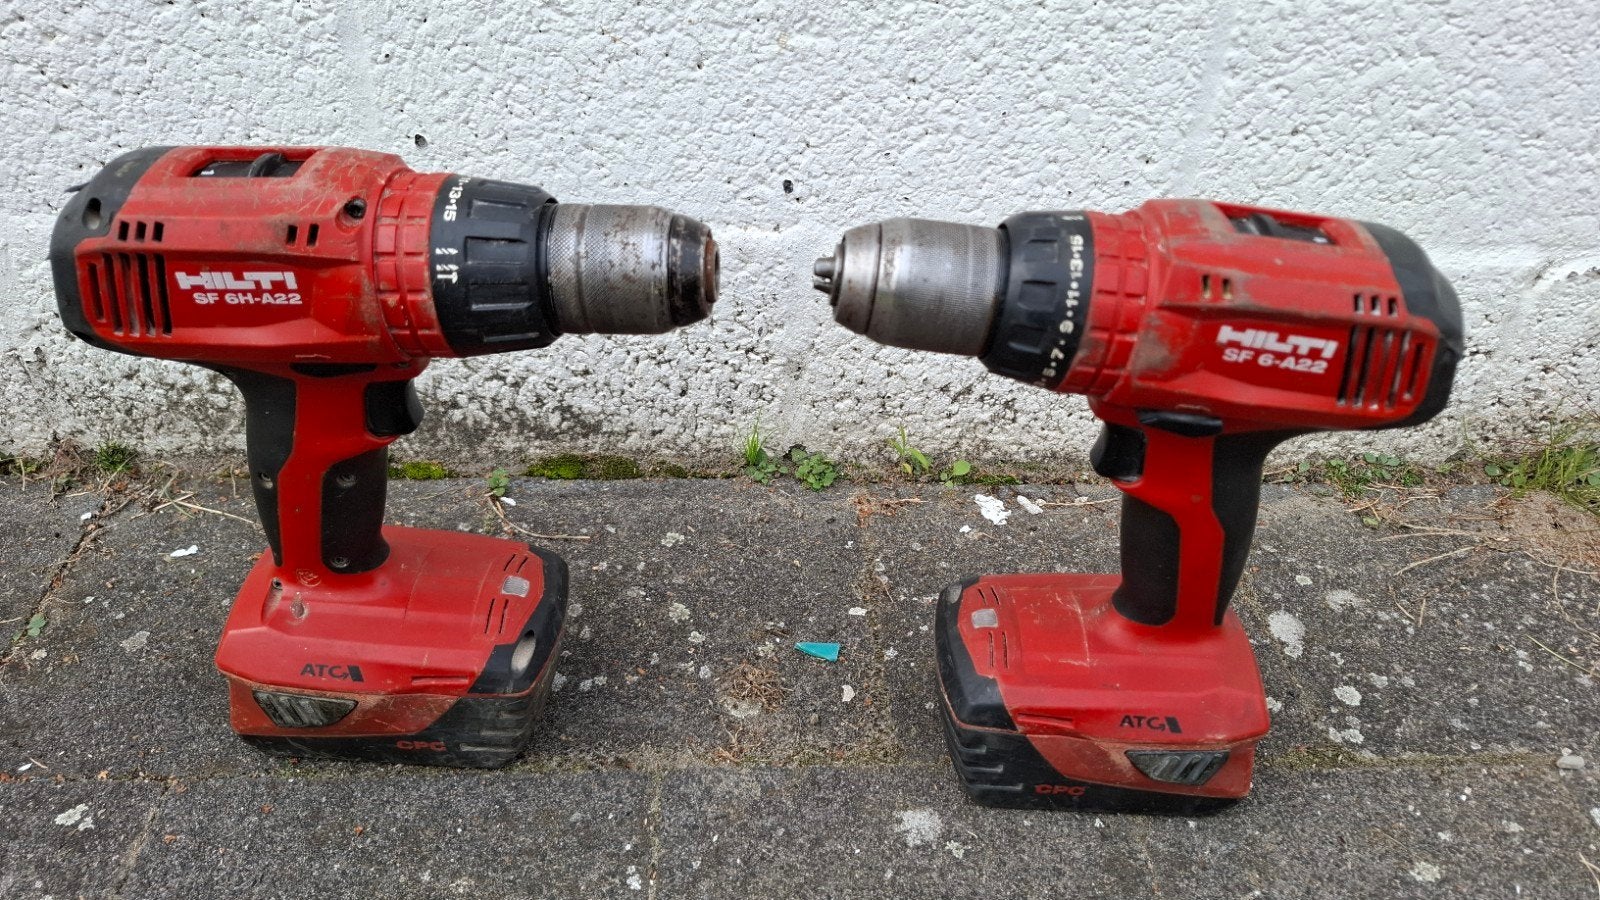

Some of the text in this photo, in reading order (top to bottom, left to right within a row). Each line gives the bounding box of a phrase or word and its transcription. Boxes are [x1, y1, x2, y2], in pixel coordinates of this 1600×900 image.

[174, 271, 298, 290] HILTI
[193, 292, 303, 305] SF 6H-A22
[1216, 324, 1339, 359] HILTI
[1222, 347, 1329, 375] SF 6-A22
[396, 740, 447, 752] CPC
[1035, 783, 1087, 797] CPC
